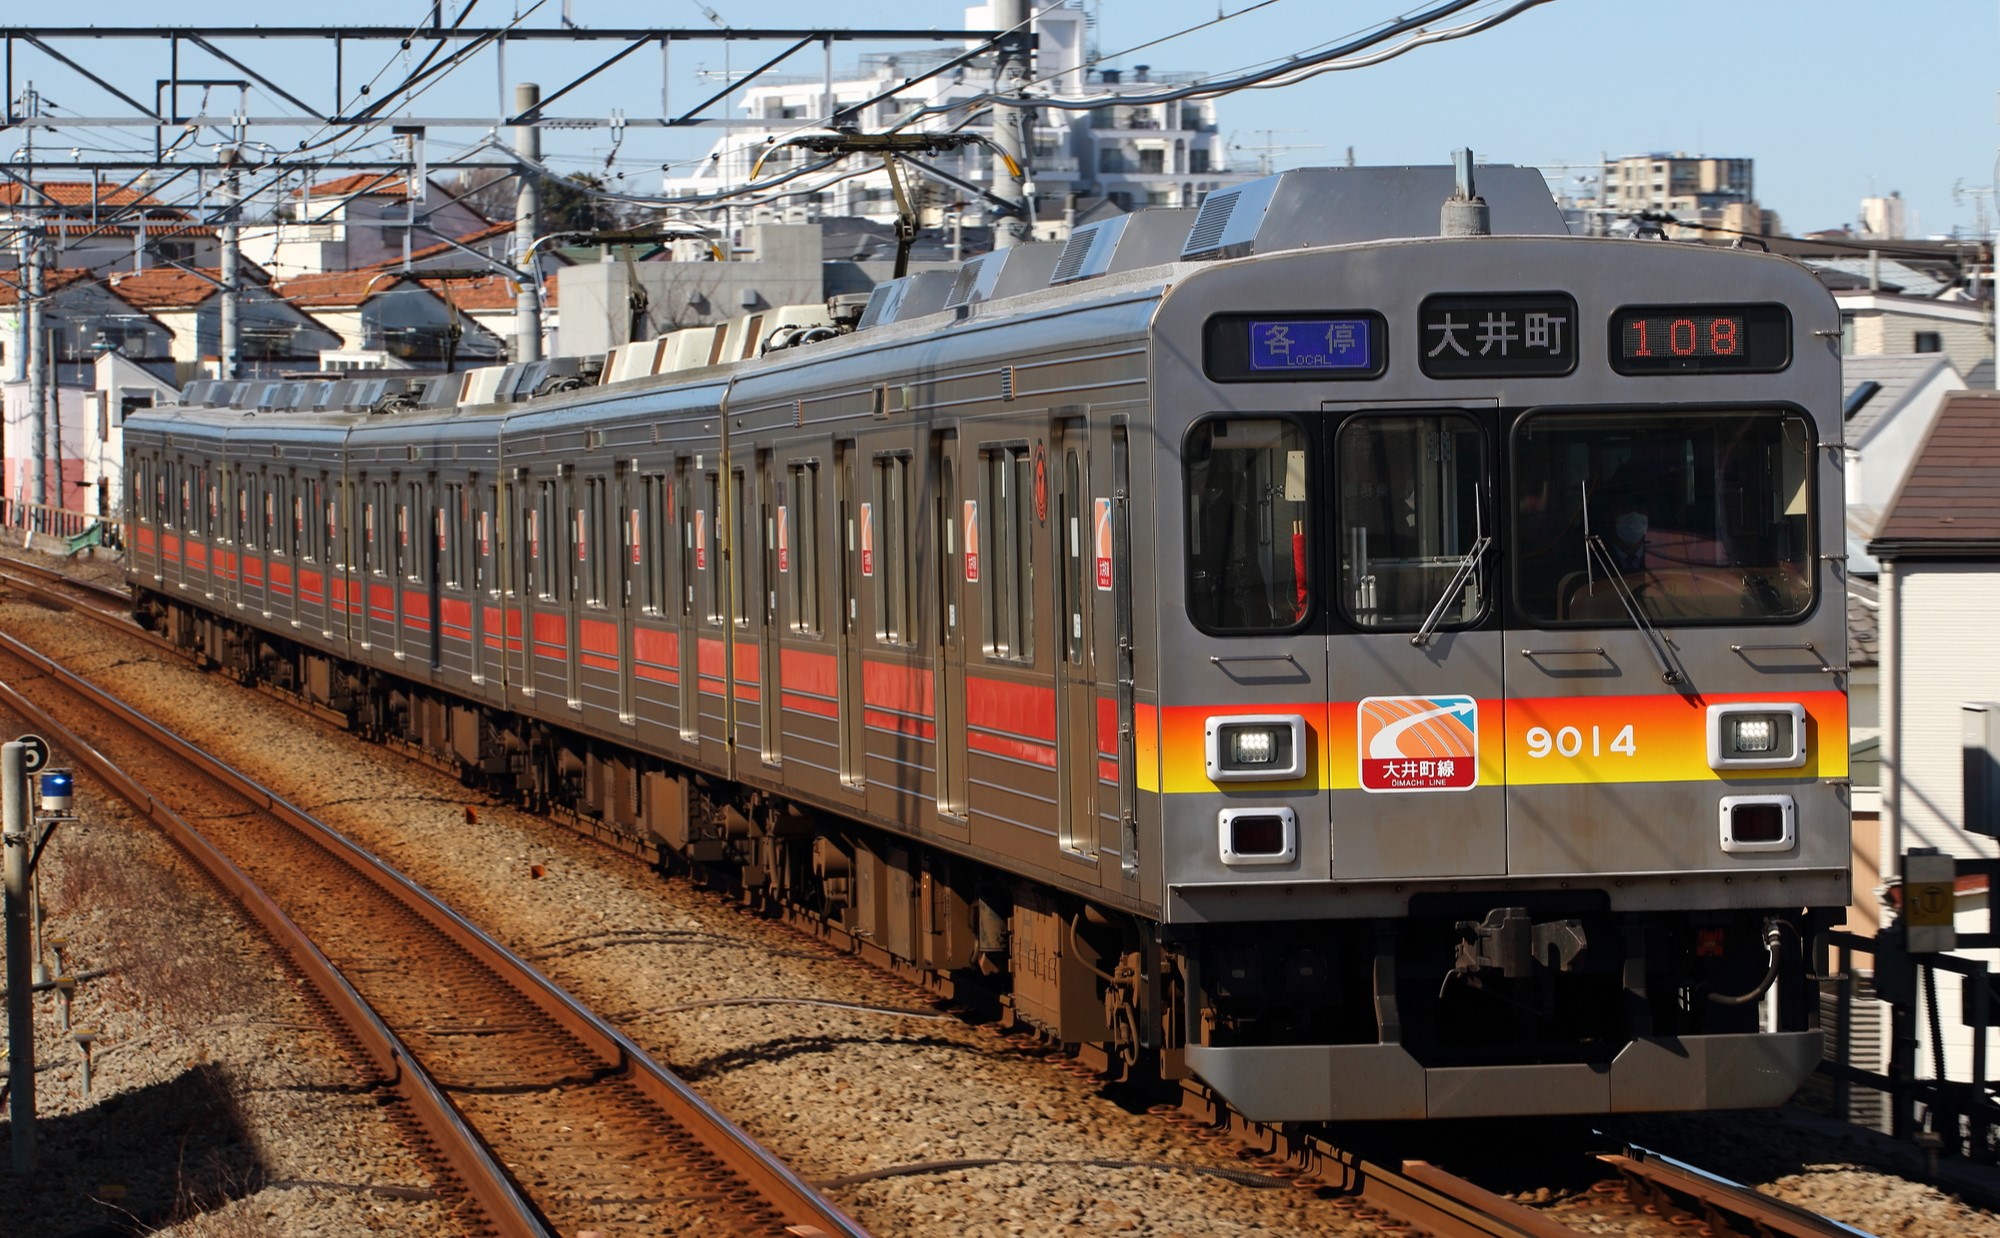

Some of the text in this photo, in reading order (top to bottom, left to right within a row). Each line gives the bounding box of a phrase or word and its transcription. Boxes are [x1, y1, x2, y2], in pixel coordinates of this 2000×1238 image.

[1264, 323, 1357, 355] 各停
[1427, 312, 1567, 357] 大井町
[1631, 318, 1738, 356] 108
[1287, 354, 1331, 366] LOCAL
[1526, 724, 1636, 758] 9014
[1382, 759, 1455, 779] 大井町線
[1429, 778, 1447, 786] LINE
